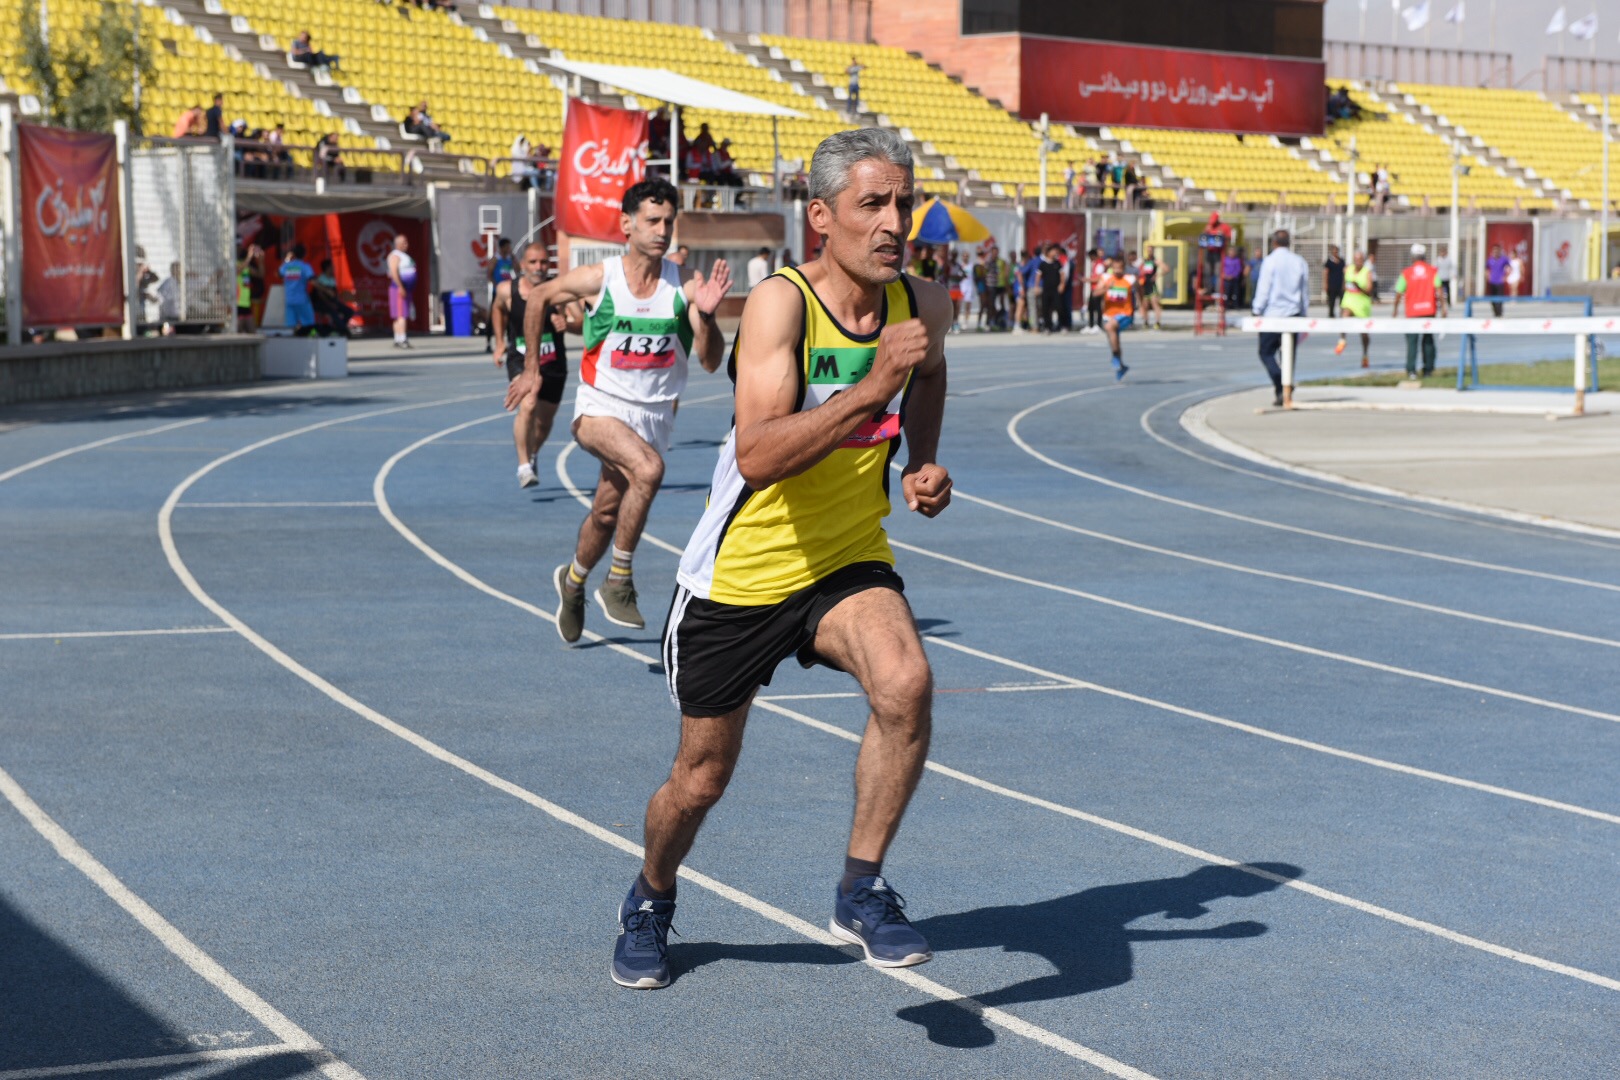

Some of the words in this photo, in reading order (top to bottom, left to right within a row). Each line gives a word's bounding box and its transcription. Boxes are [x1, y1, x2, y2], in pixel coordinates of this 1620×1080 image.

[1169, 76, 1208, 106] ورزش
[1209, 81, 1249, 107] حامی
[616, 320, 632, 332] M
[616, 336, 671, 357] 432
[813, 355, 840, 378] M
